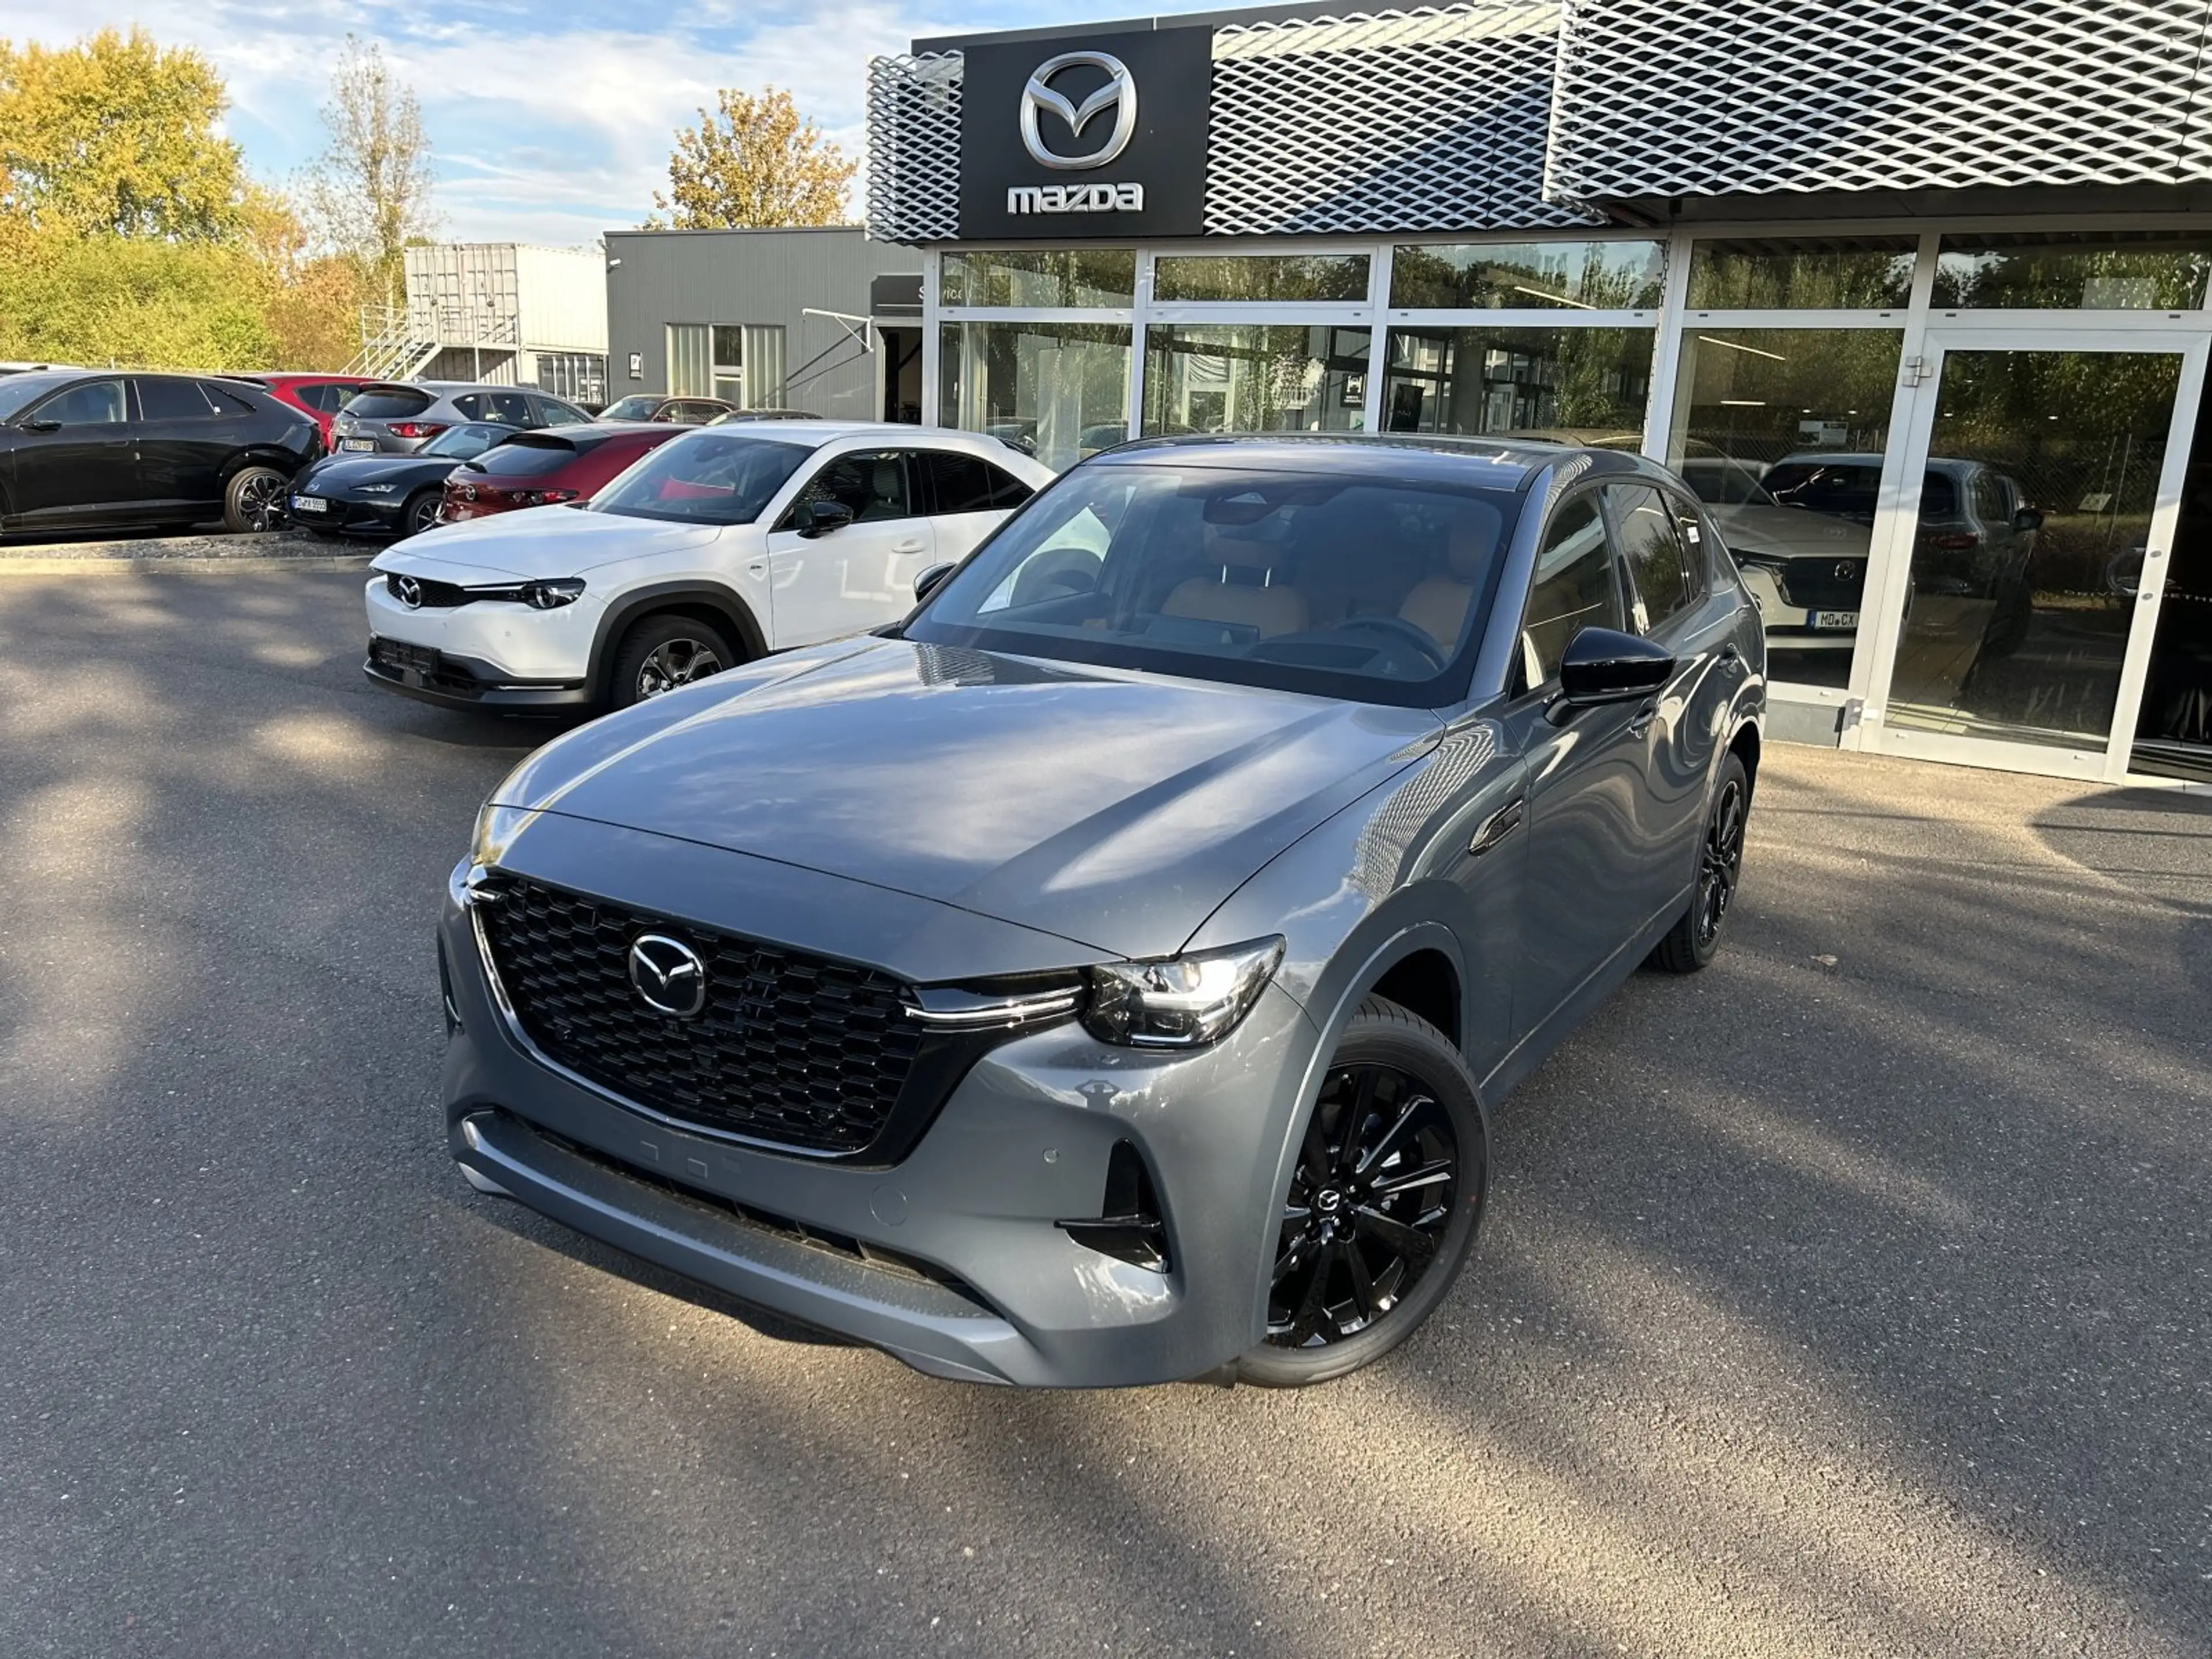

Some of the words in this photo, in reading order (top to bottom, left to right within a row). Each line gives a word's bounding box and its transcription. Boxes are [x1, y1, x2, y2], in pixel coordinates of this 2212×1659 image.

[1007, 182, 1144, 215] mazda
[1821, 613, 1835, 626] MD
[1842, 613, 1854, 626] CX
